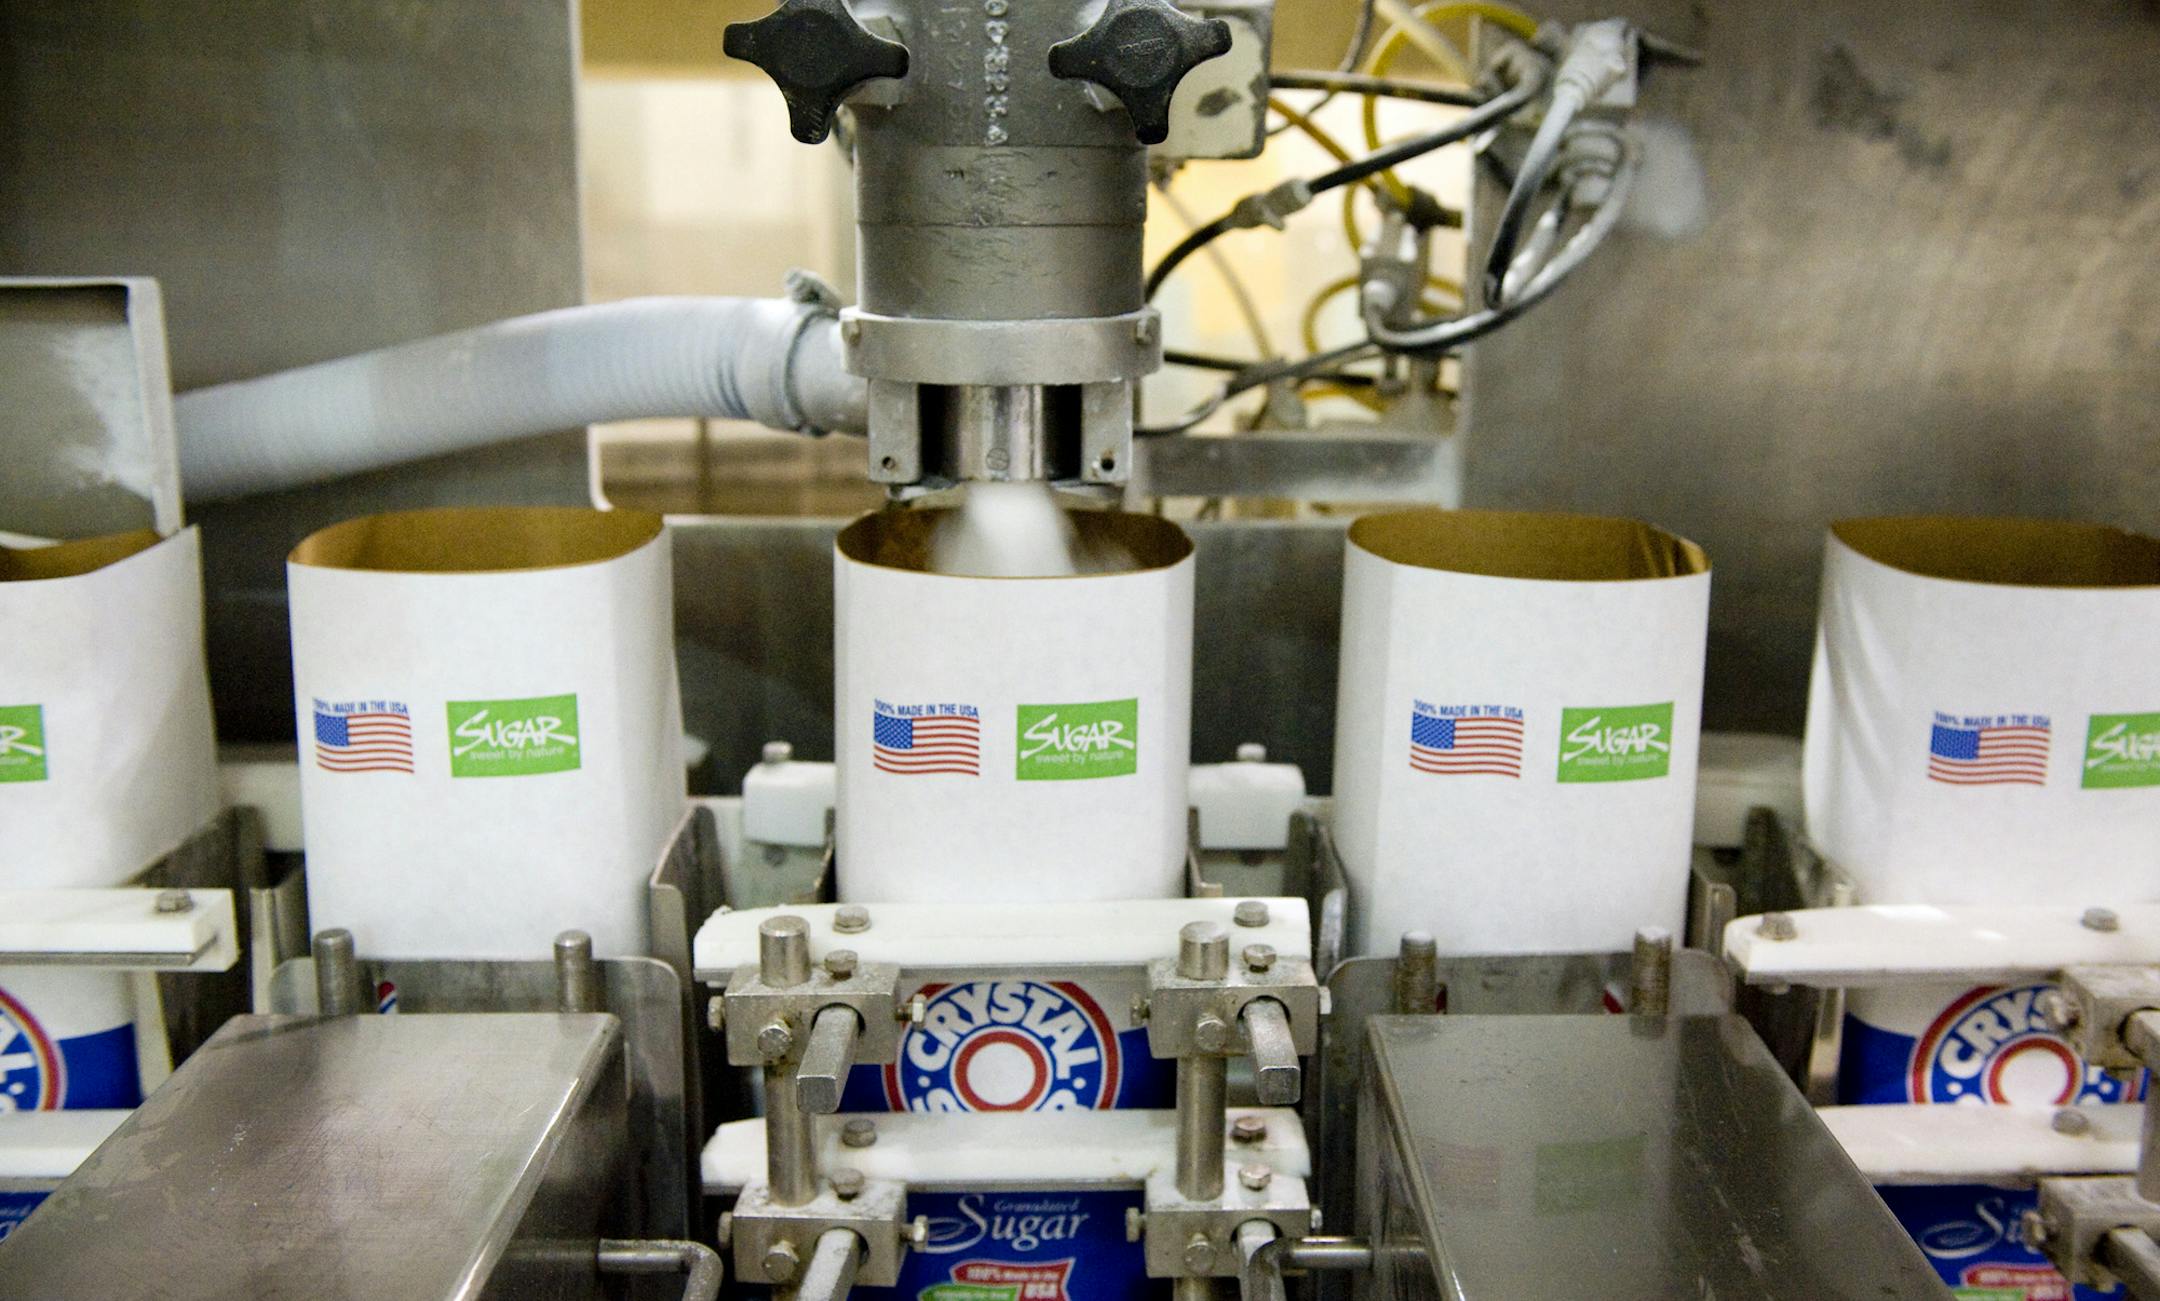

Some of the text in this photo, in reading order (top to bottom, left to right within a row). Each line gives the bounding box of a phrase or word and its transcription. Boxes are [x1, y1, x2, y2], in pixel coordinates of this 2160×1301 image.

[333, 702, 355, 713] MADE
[359, 701, 367, 712] IN
[370, 700, 386, 712] THE
[389, 701, 408, 714] USA
[874, 698, 979, 718] 100% MADE IN THE USA
[1440, 705, 1466, 717] MADE
[1470, 704, 1480, 716] IN
[1483, 704, 1501, 717] THE
[1504, 705, 1523, 719] USA
[454, 709, 577, 756] SUGAR
[1020, 712, 1135, 759] SUGAR
[1562, 715, 1669, 762] SUGAR
[1035, 749, 1125, 765] sweet by nature
[907, 982, 1099, 1080] CRYSTAL
[926, 1194, 1090, 1252] Sugar
